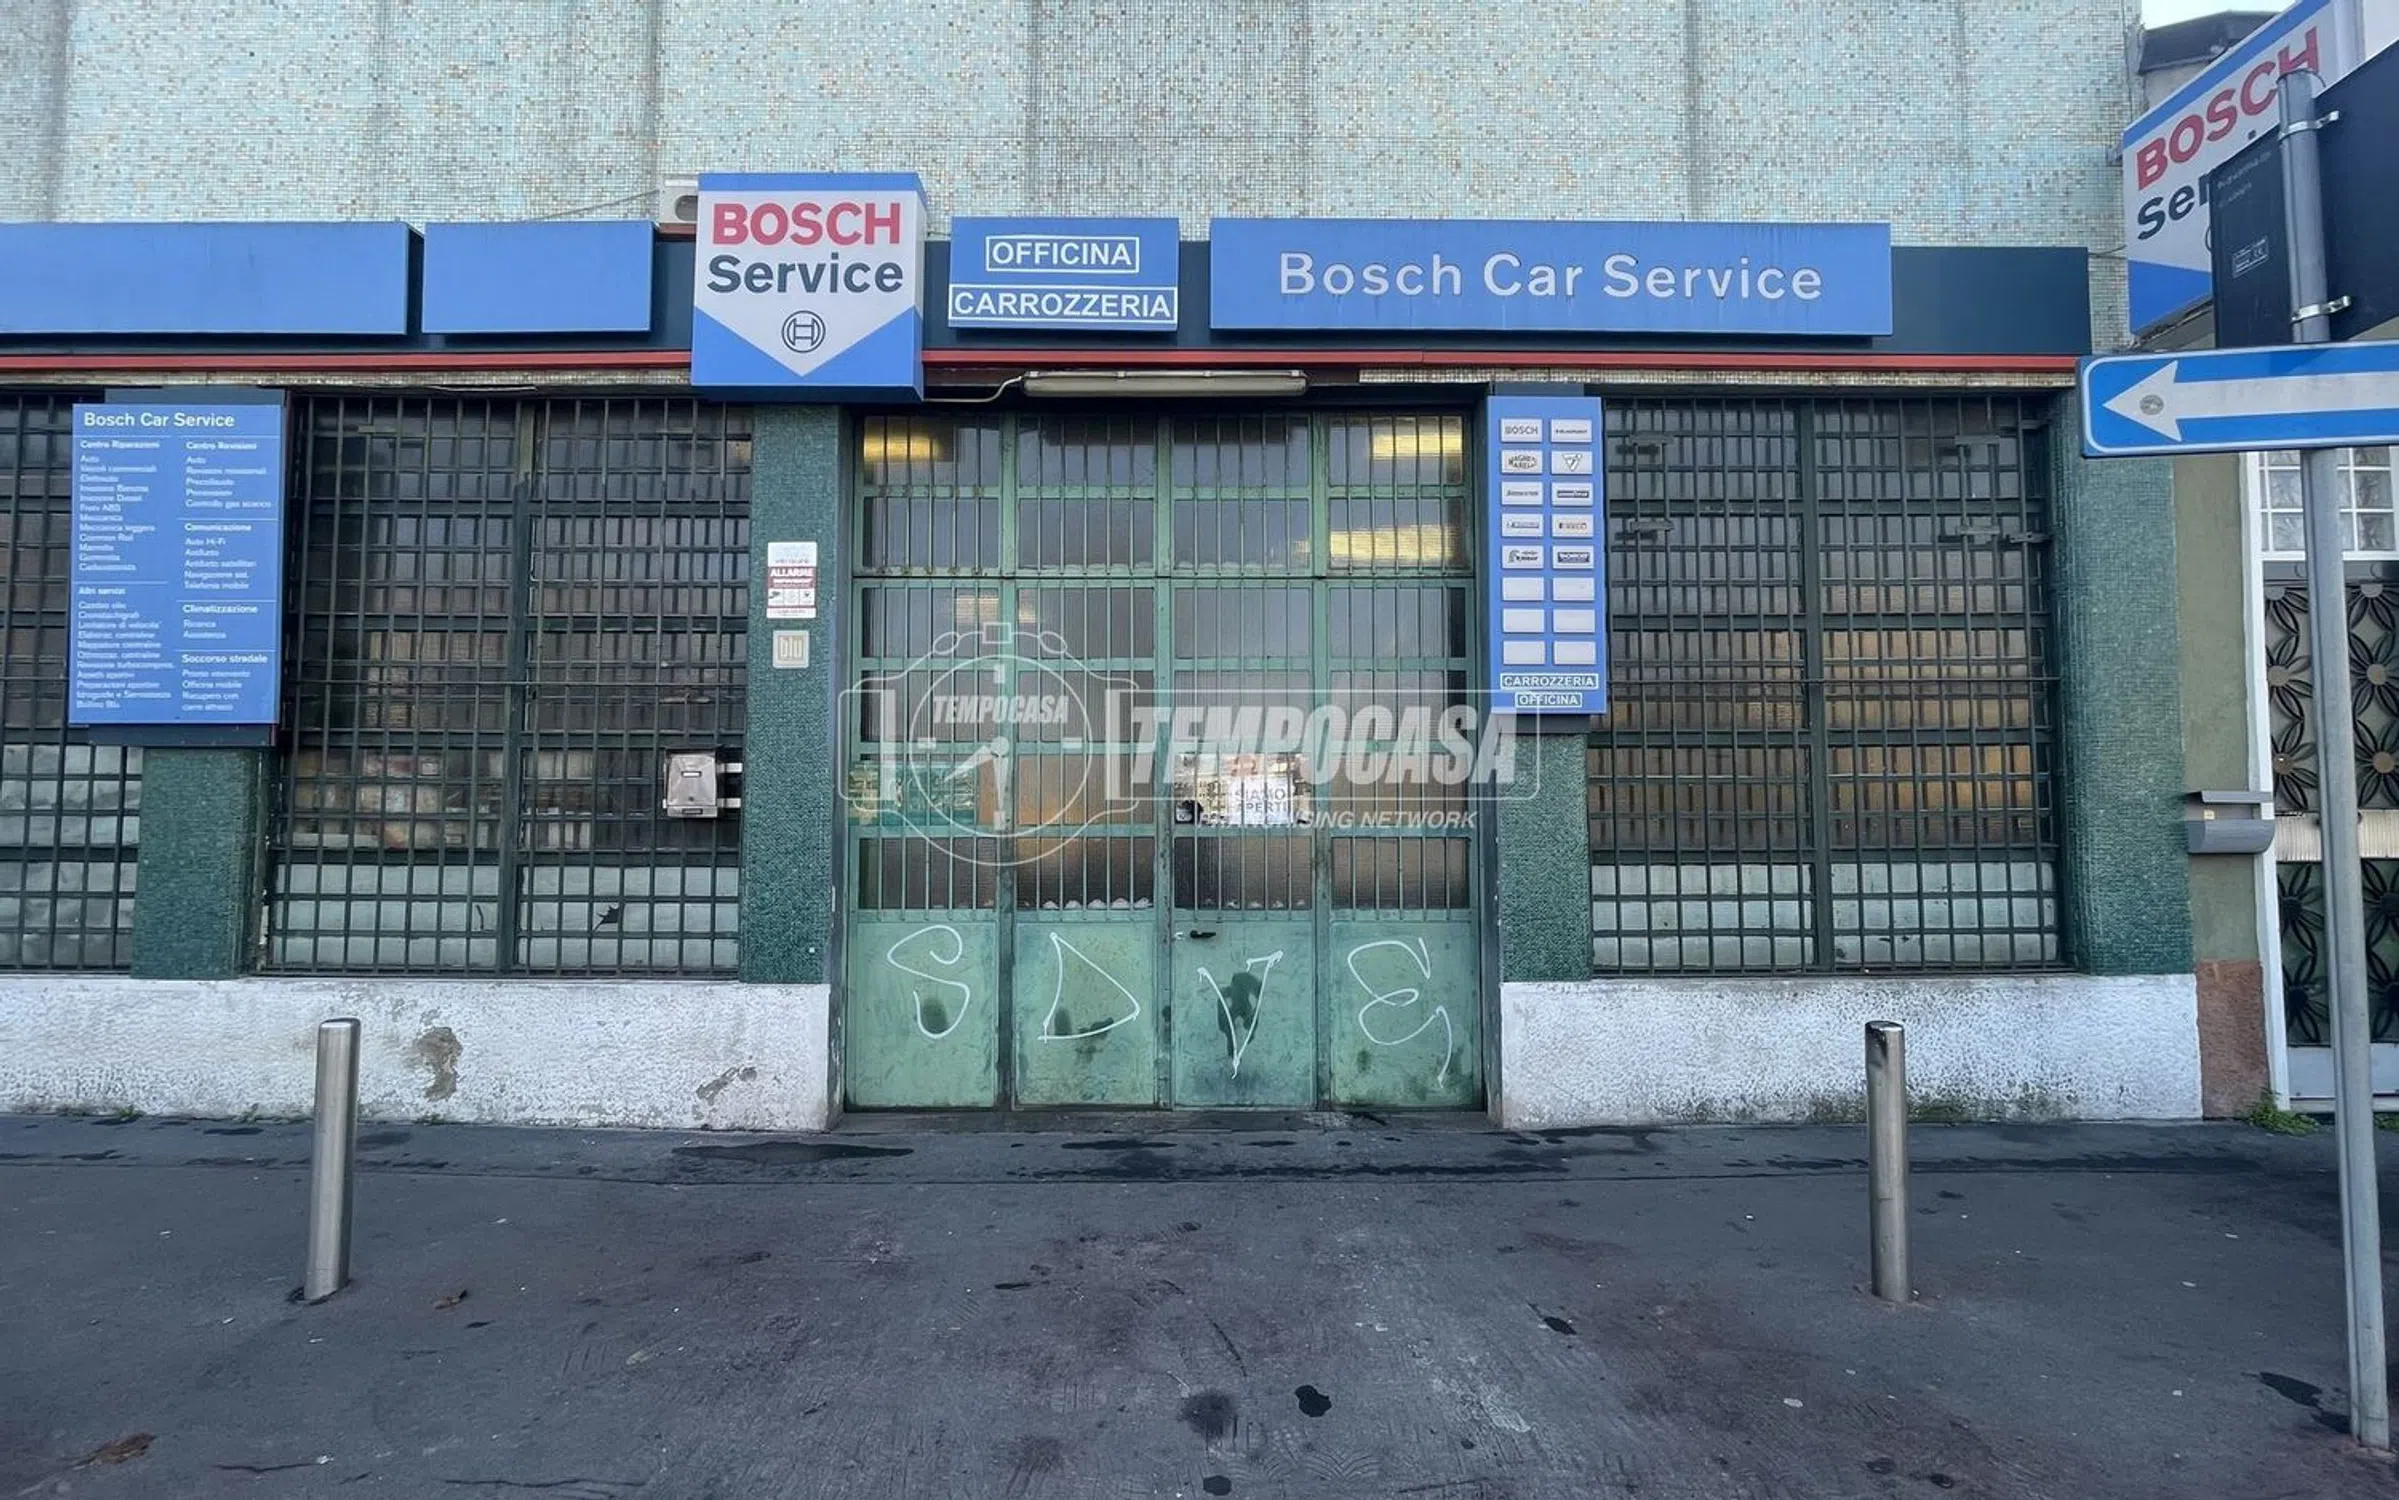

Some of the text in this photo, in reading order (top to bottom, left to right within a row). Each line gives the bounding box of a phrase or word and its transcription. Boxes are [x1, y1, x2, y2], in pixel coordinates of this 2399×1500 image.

[2136, 26, 2320, 191] BOSCH
[713, 202, 901, 246] BOSCH
[992, 241, 1132, 266] OFFICINA
[707, 252, 904, 294] Service
[1280, 252, 1823, 299] Bosch Car Service
[955, 291, 1171, 318] CARROZZERIA
[83, 412, 236, 427] Bosch Car Service
[80, 441, 110, 449] Centro
[186, 442, 216, 450] Centro
[80, 455, 100, 463] Auto
[186, 456, 206, 464] Auto
[184, 523, 252, 531] Comunicazione
[182, 605, 258, 613] Climatizzazione
[182, 654, 268, 663] Soccorso stradale
[1504, 676, 1594, 687] CARROZZERIA
[1519, 695, 1579, 705] OFFICINA
